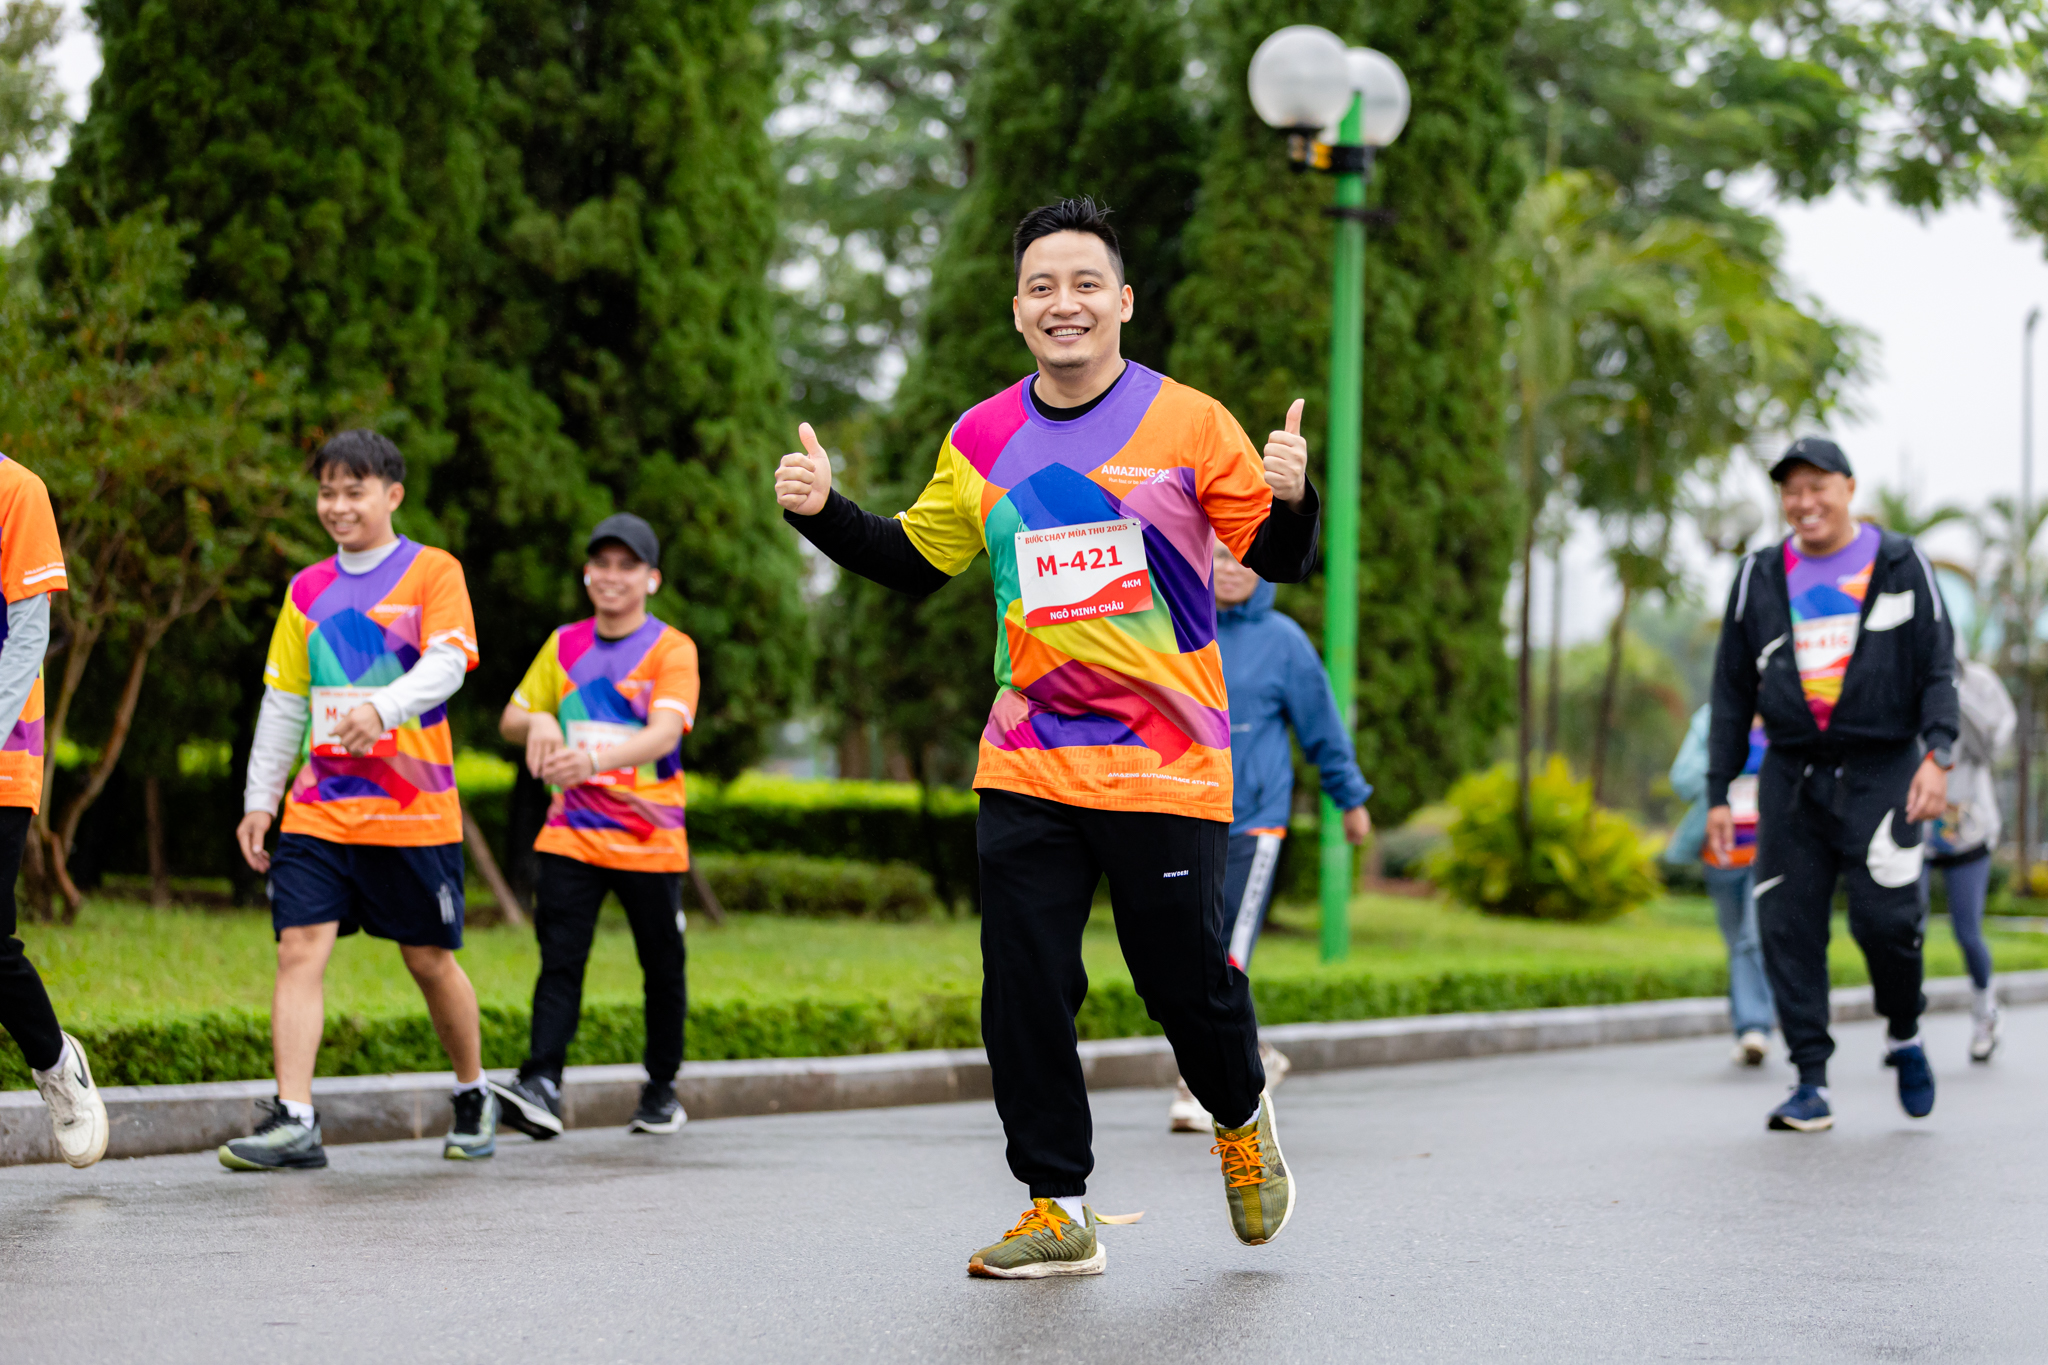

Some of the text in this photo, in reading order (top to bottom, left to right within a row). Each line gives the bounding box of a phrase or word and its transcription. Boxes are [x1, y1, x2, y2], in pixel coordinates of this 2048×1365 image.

[1101, 465, 1156, 478] AMAZING
[1044, 531, 1067, 542] CHẠY
[1068, 528, 1087, 538] MÙA
[1088, 526, 1105, 536] THU
[1106, 523, 1128, 533] 2025
[1036, 545, 1123, 578] M-421
[1121, 578, 1142, 589] 4KM
[1050, 600, 1124, 620] NGÔ MINH CHÂU
[1141, 772, 1172, 780] AUTUMN
[1172, 776, 1190, 784] RACE
